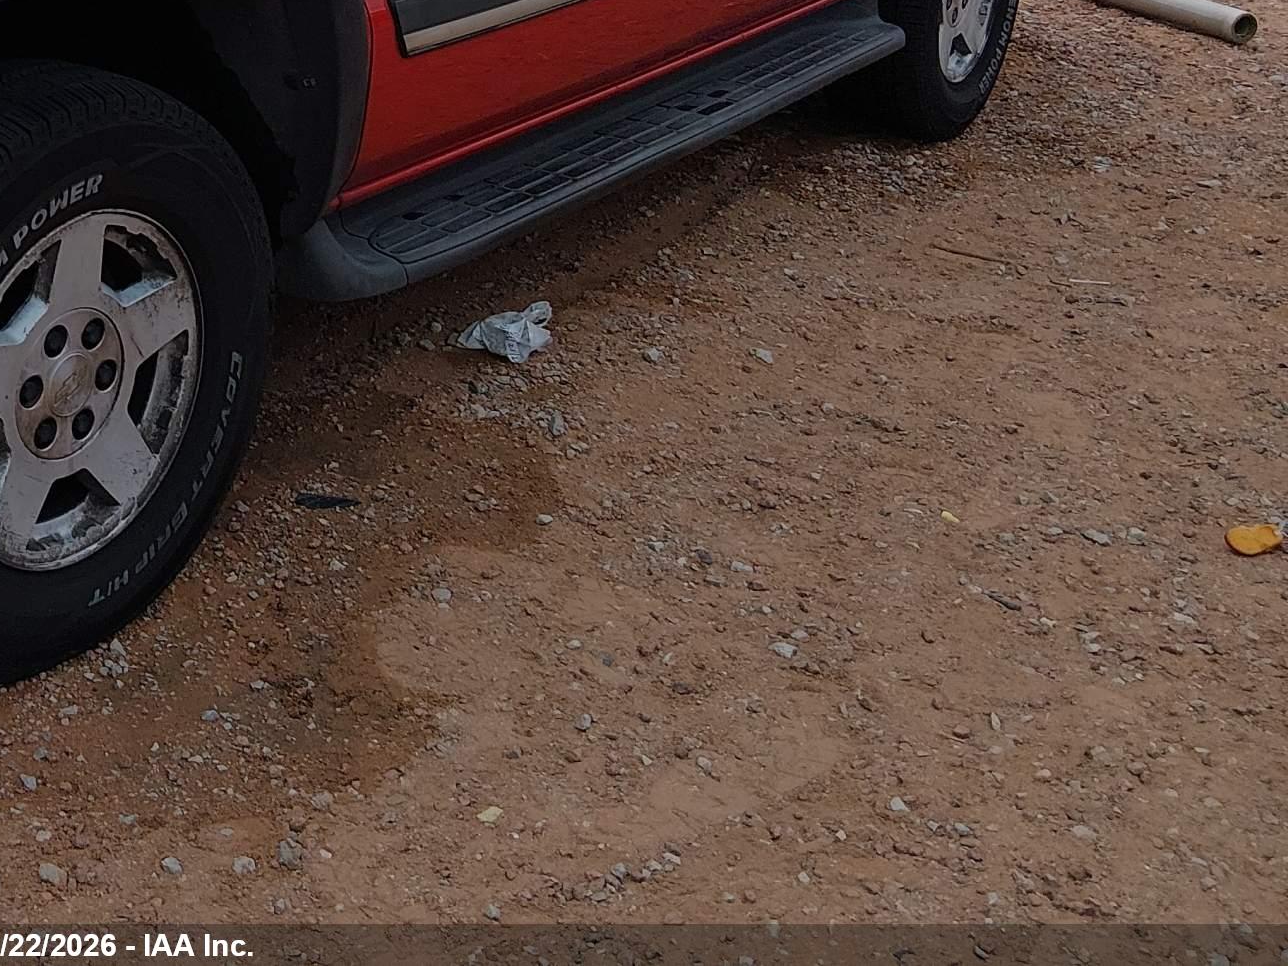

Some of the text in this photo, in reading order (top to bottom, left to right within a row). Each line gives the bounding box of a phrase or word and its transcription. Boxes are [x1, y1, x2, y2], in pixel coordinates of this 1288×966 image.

[978, 48, 1001, 95] POWER
[12, 174, 104, 250] POWER
[87, 351, 243, 607] COVERT GRIP H/T
